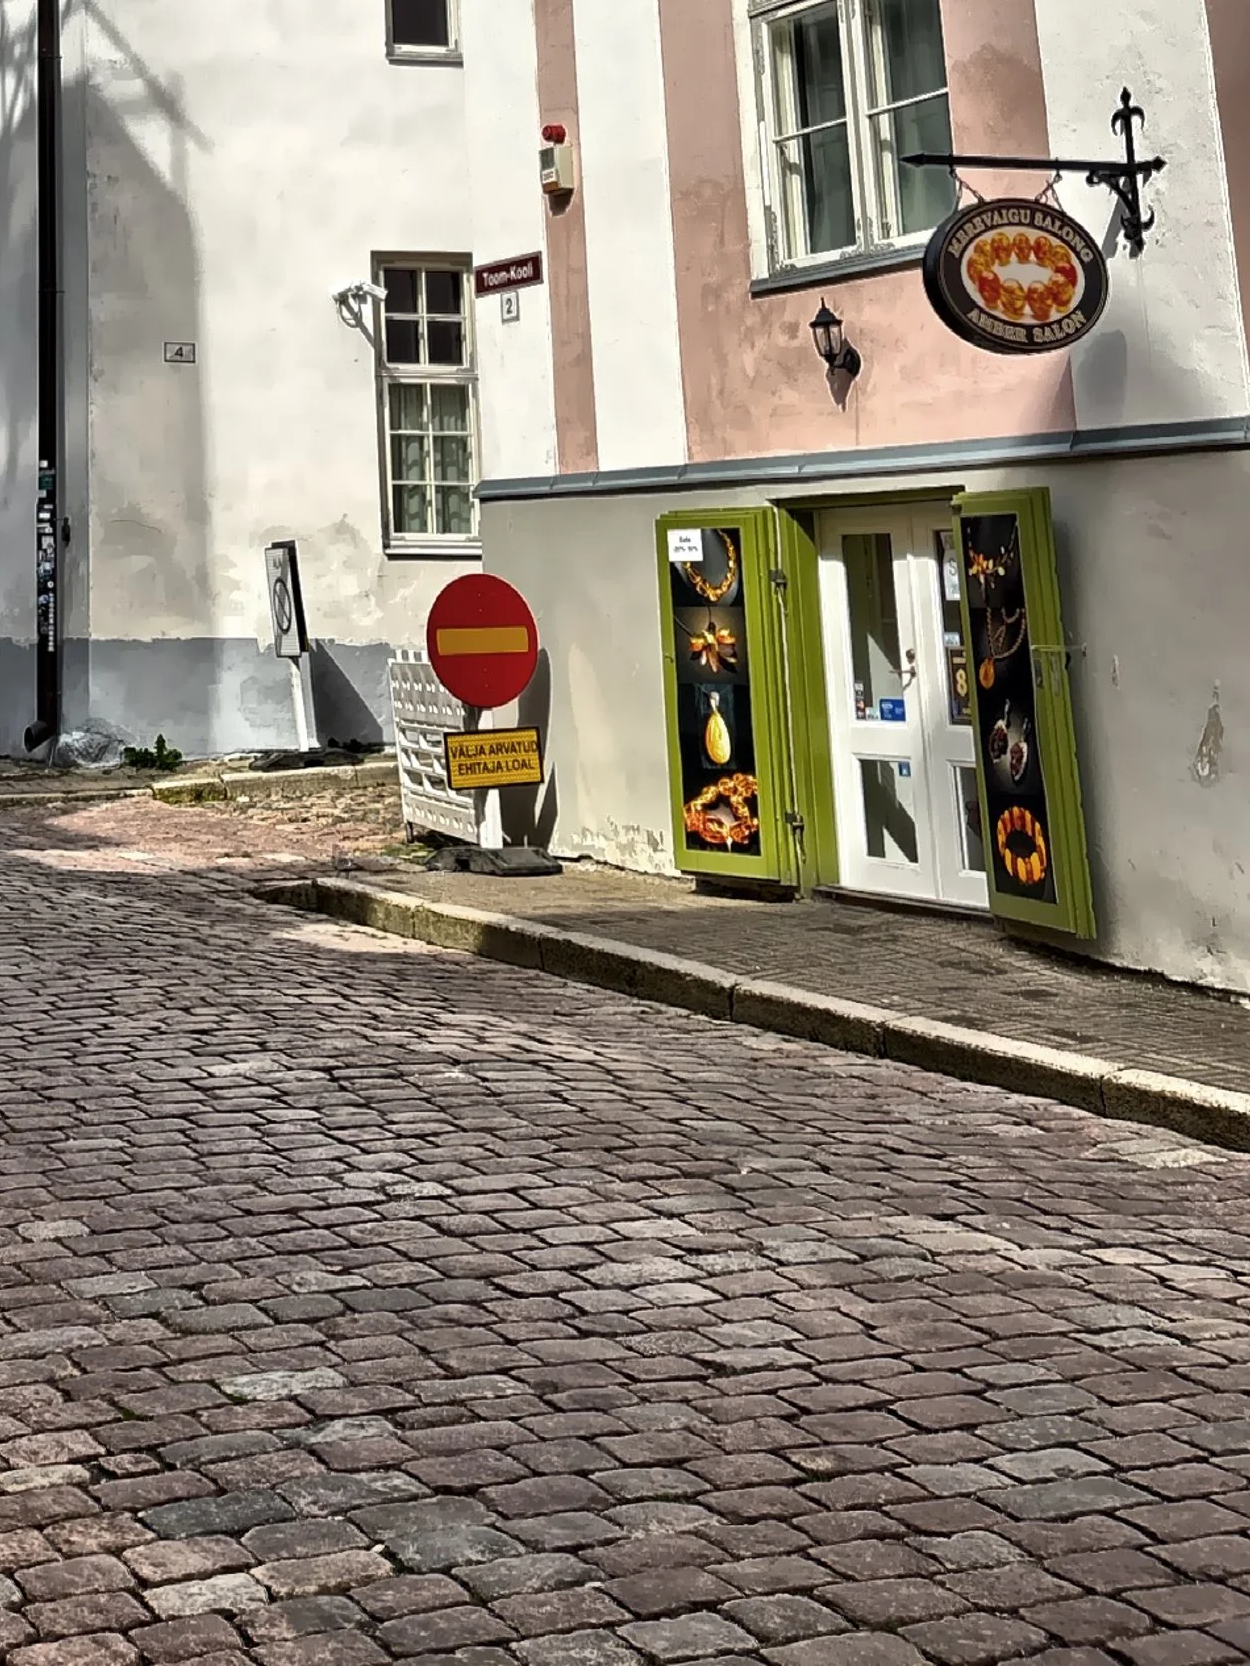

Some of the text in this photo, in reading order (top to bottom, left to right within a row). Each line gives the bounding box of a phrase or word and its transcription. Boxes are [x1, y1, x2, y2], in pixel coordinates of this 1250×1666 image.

[948, 209, 1094, 263] MEREVAIGU SALONG
[482, 261, 533, 287] Toom-Kooli
[505, 298, 513, 315] 2
[967, 308, 1087, 343] AMBER SALON
[174, 346, 183, 358] 4
[489, 740, 537, 756] ARVATUD
[458, 759, 535, 775] EHITAJA LOAL
